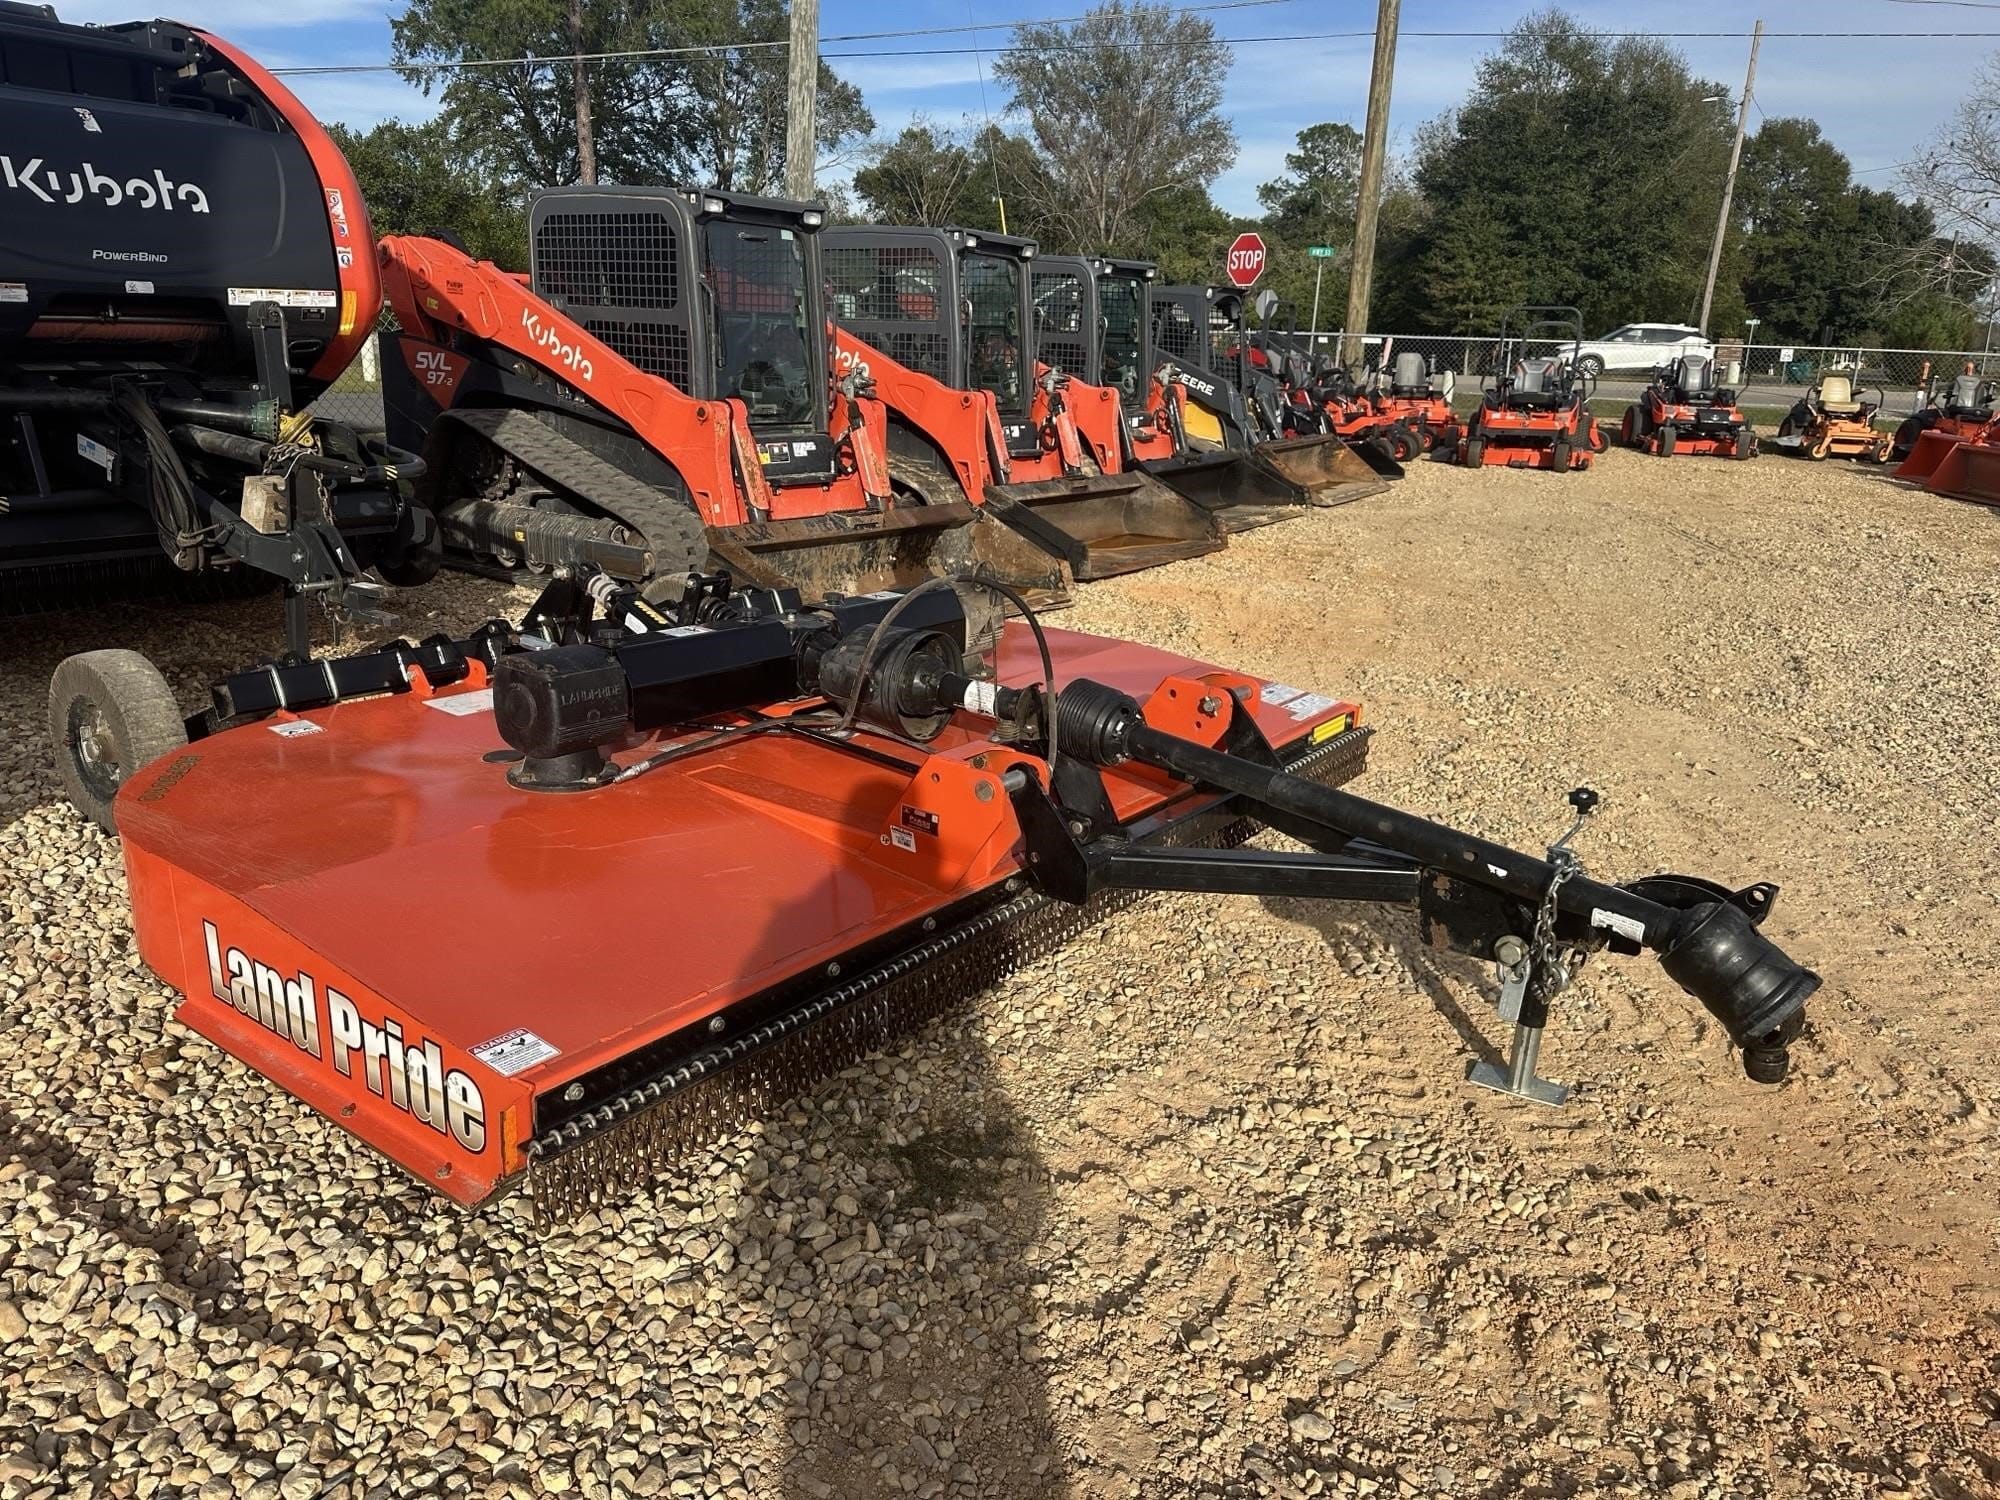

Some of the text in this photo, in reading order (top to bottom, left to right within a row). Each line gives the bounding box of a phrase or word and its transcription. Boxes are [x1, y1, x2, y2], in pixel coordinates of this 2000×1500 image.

[0, 156, 210, 213] Kubota
[1230, 250, 1263, 270] STOP
[415, 351, 452, 371] SVL
[521, 307, 593, 383] Kubota
[202, 918, 487, 1156] Land Pride
[481, 1028, 527, 1051] DANGER
